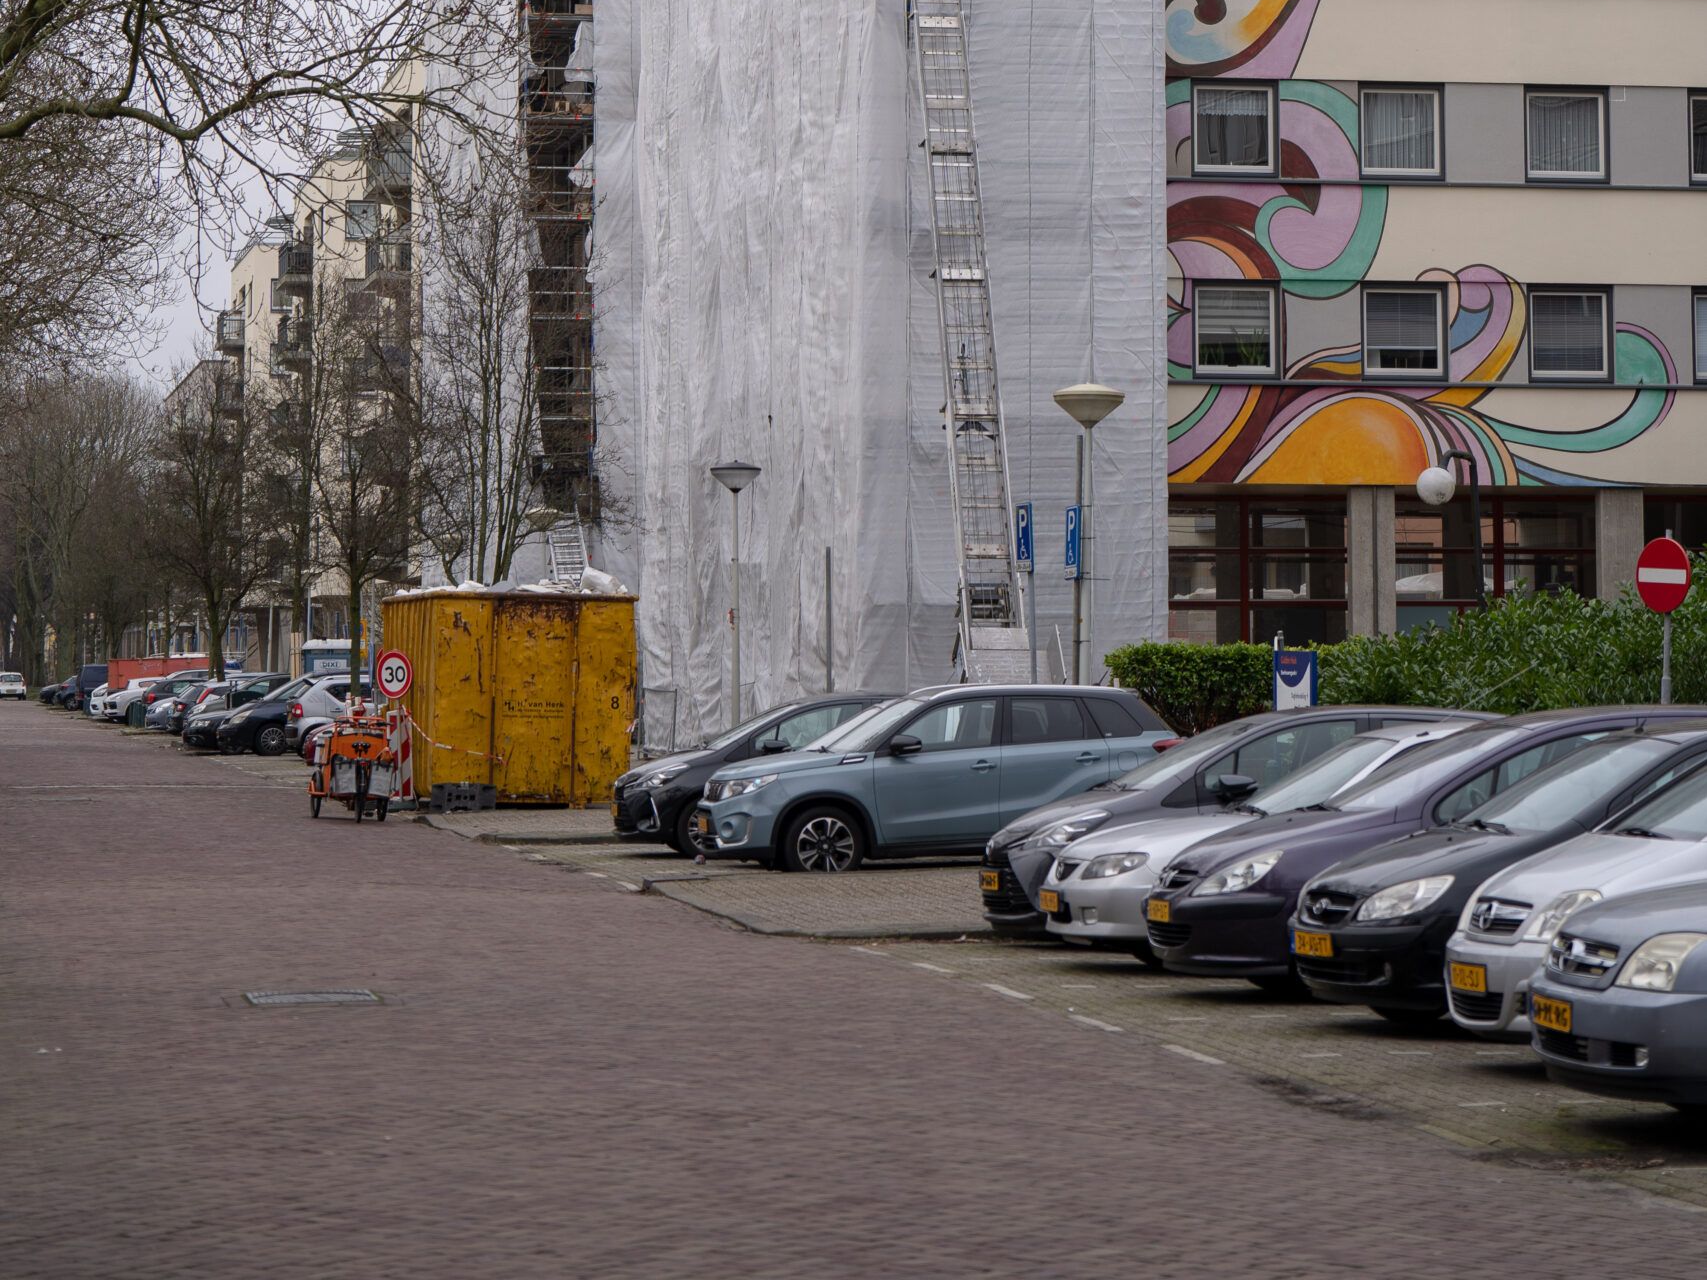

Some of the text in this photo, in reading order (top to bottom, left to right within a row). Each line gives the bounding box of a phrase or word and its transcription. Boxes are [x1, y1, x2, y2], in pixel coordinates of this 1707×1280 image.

[1018, 509, 1027, 538] P
[1067, 510, 1076, 542] P
[384, 665, 406, 684] 30
[610, 695, 620, 710] 8
